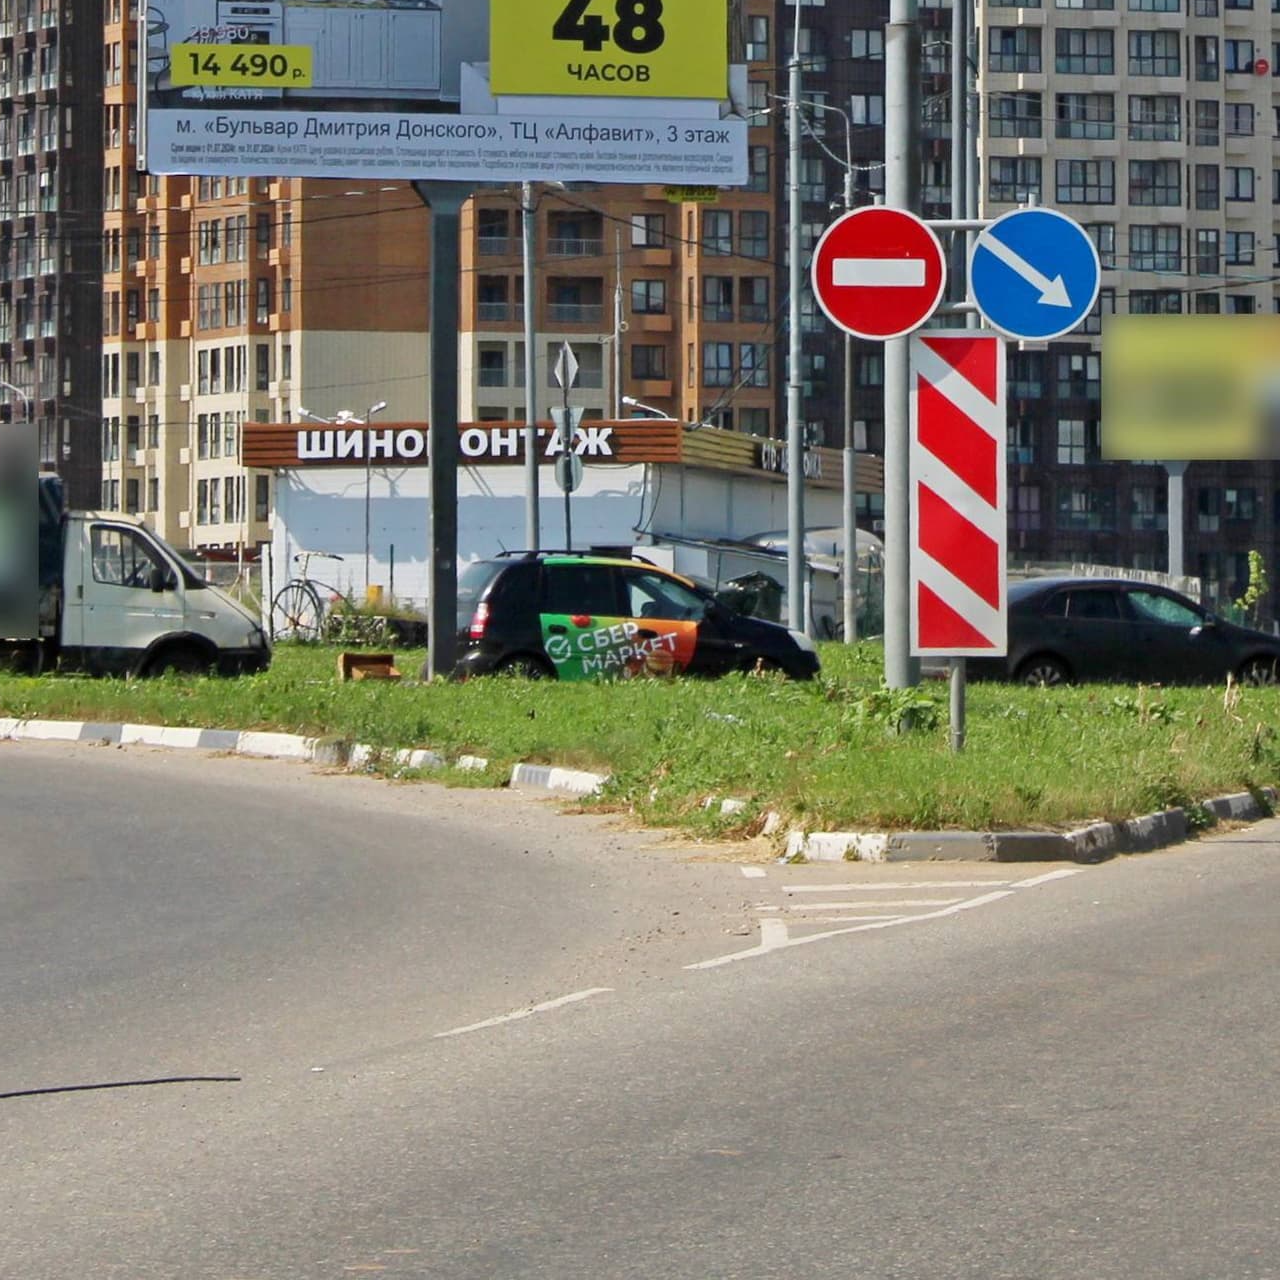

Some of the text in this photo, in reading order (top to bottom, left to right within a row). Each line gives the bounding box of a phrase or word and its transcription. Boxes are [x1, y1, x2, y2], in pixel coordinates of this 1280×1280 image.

[189, 53, 221, 76] 14
[230, 53, 288, 77] 490
[567, 63, 650, 82] ЧАСОВ
[176, 116, 730, 145] м. «Бульвар Дмитрия Донского», ТЦ «Алфавит», 3 этаж
[297, 427, 613, 459] ШИНООНАЖ
[577, 622, 639, 651] СБЕР
[582, 632, 678, 674] МАРКЕТ
